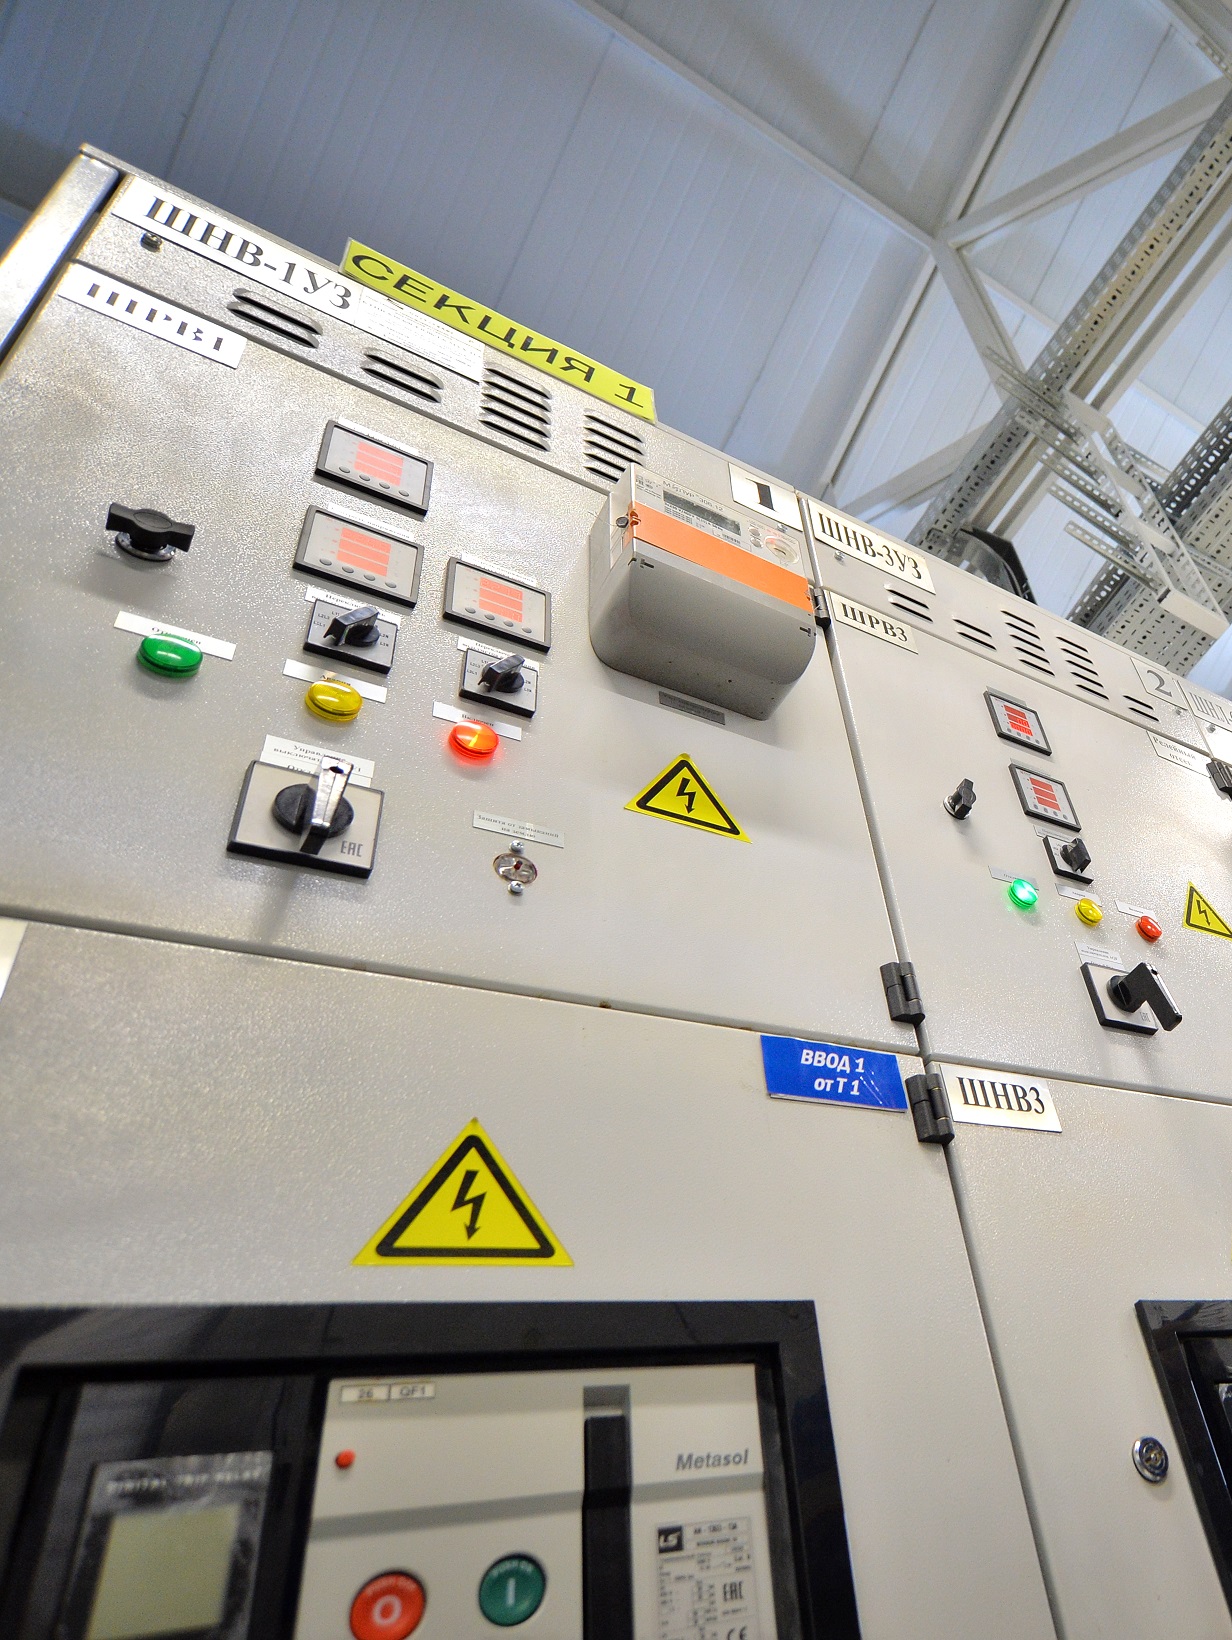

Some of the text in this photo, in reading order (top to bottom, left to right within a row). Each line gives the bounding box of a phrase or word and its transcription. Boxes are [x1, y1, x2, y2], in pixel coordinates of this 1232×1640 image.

[352, 255, 596, 383] СЕКЦИЯ
[614, 383, 645, 408] 1
[744, 478, 779, 512] 1
[1146, 669, 1173, 698] 2
[800, 1049, 865, 1073] ВВОД 1
[814, 1078, 835, 1093] от
[850, 1080, 860, 1095] 1
[675, 1449, 750, 1472] Metasol
